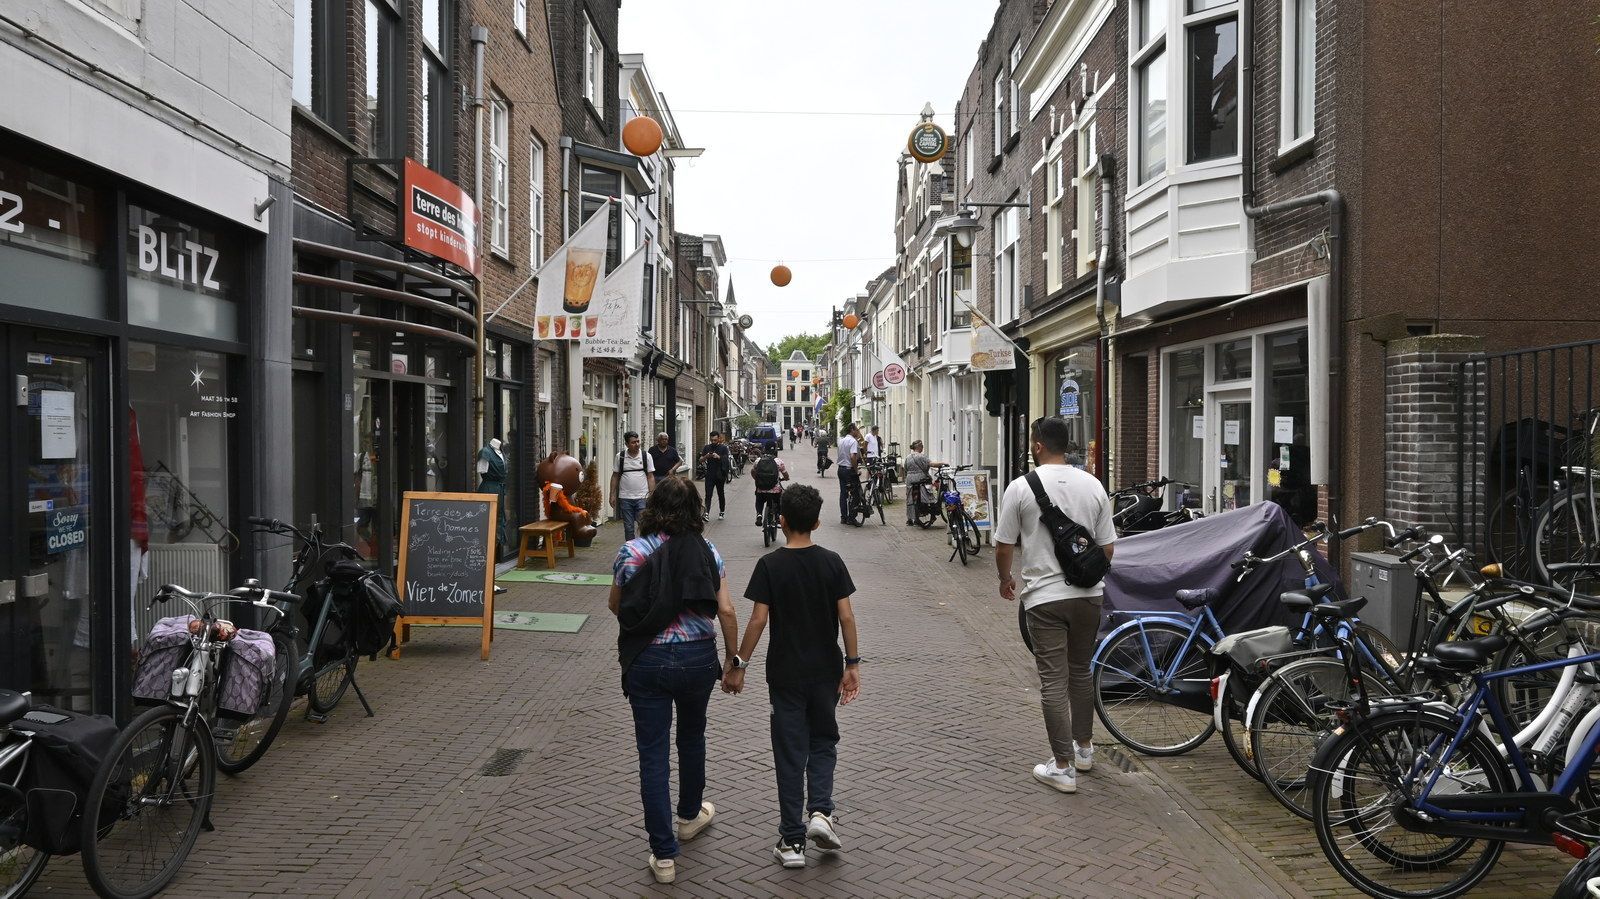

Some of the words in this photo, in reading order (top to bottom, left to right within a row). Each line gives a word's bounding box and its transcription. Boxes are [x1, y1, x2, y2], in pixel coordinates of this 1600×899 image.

[415, 193, 441, 218] terre
[441, 206, 456, 226] des
[416, 222, 438, 240] stopt
[1061, 391, 1078, 408] SIDE
[414, 502, 441, 516] Terre
[444, 507, 461, 517] des
[52, 511, 79, 527] Sorry
[444, 520, 479, 532] hommes
[49, 530, 85, 549] CLOSED
[406, 580, 436, 603] Vier
[437, 581, 449, 592] de
[447, 581, 484, 604] Zomer
